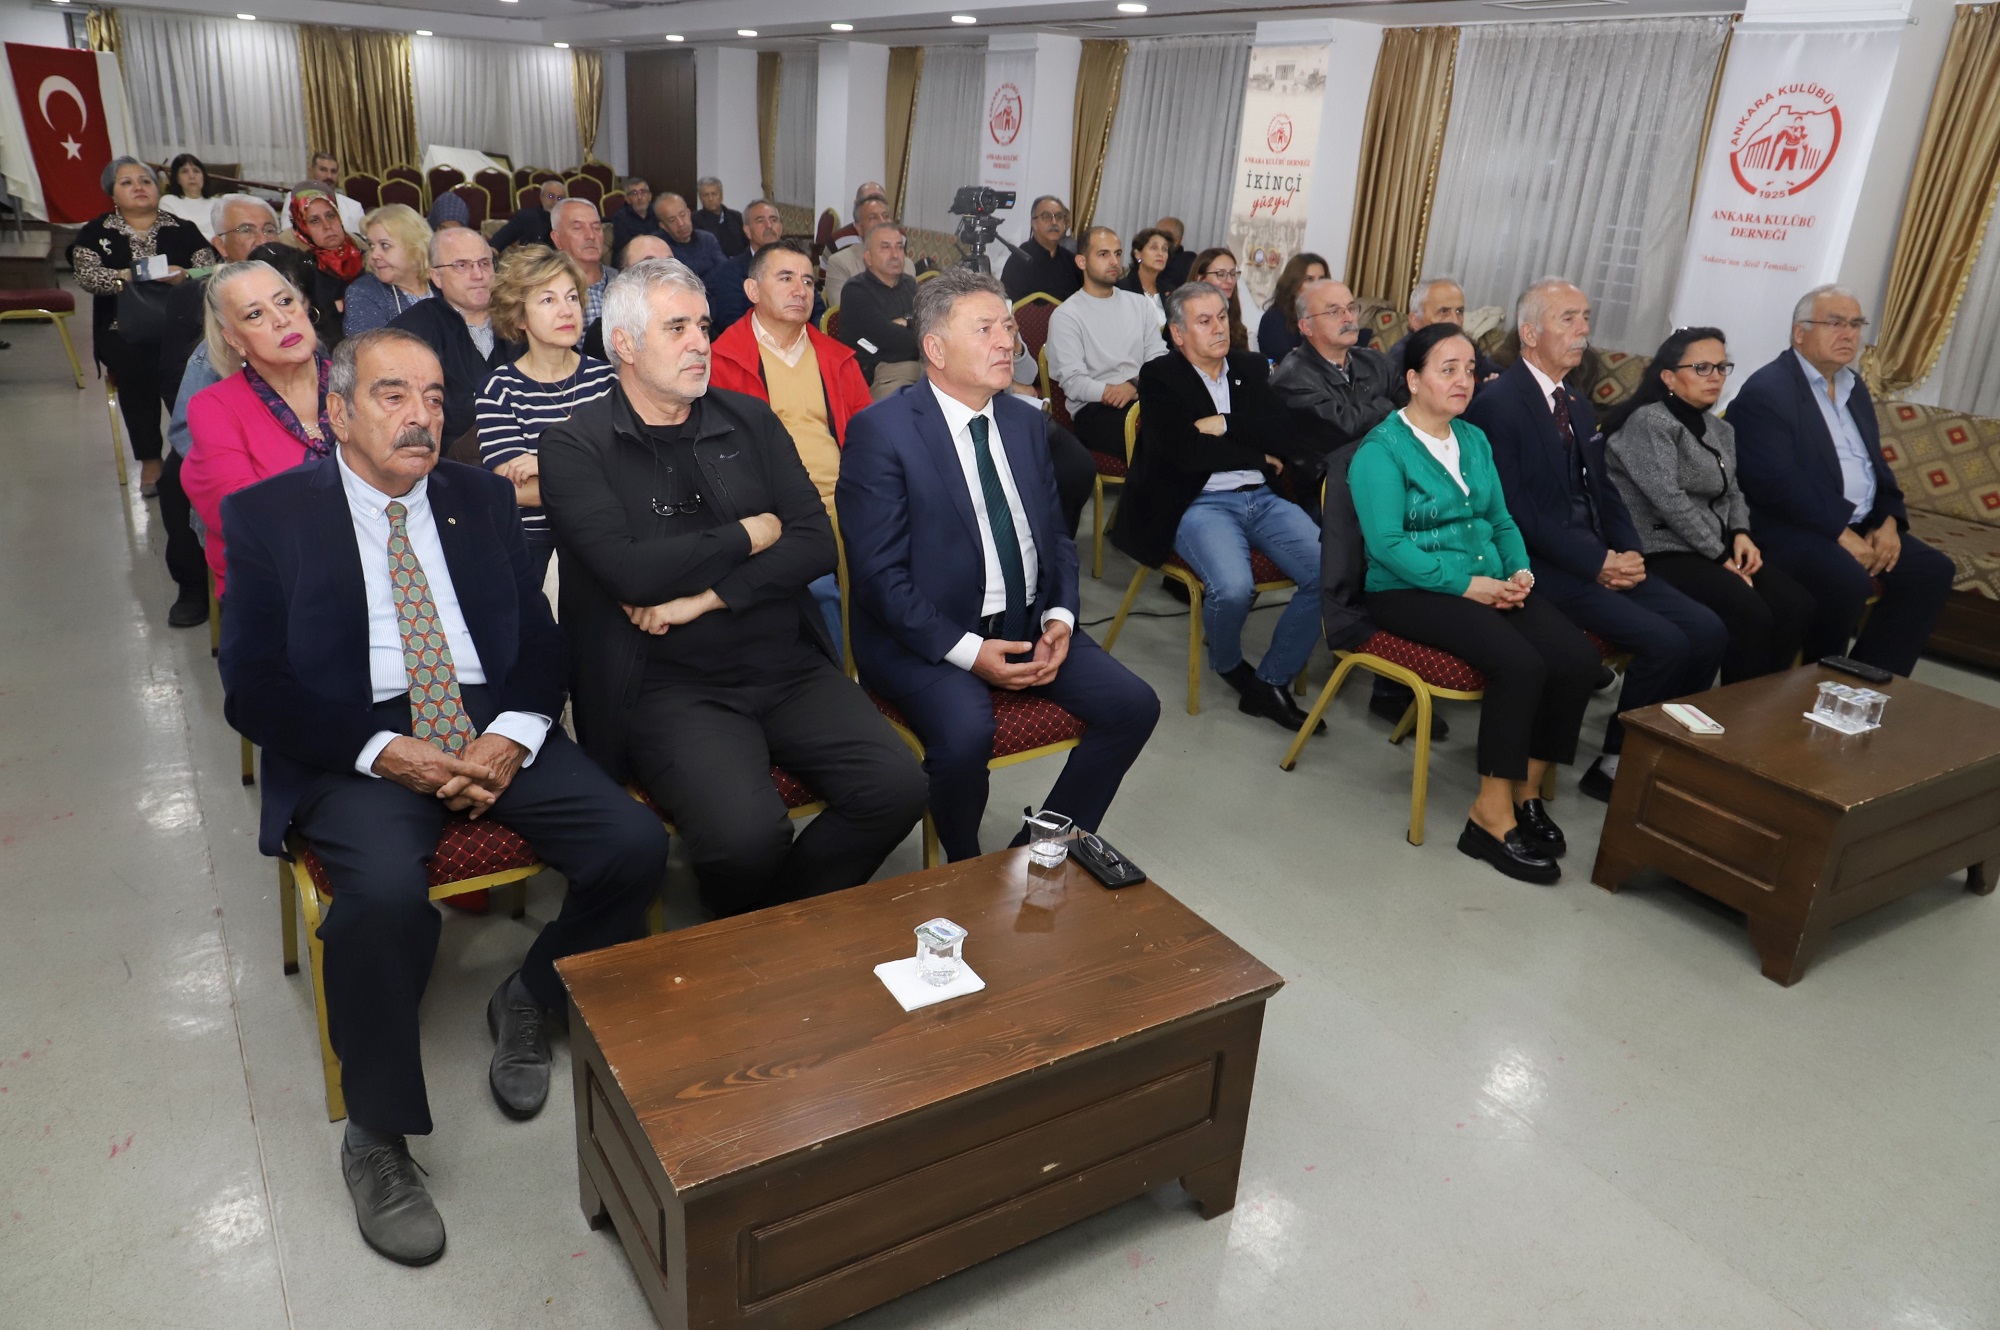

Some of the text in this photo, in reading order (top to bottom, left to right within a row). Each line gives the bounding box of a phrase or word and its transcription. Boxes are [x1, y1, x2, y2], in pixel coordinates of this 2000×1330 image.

[1731, 82, 1835, 146] ANKARA KULÜBÜ
[1246, 170, 1302, 192] İKİNCİ
[1250, 187, 1295, 218] yüzyıl
[1759, 189, 1786, 199] 1925
[1711, 210, 1816, 228] ANKARA KULÜBÜ
[1731, 226, 1788, 241] DERNEĞİ
